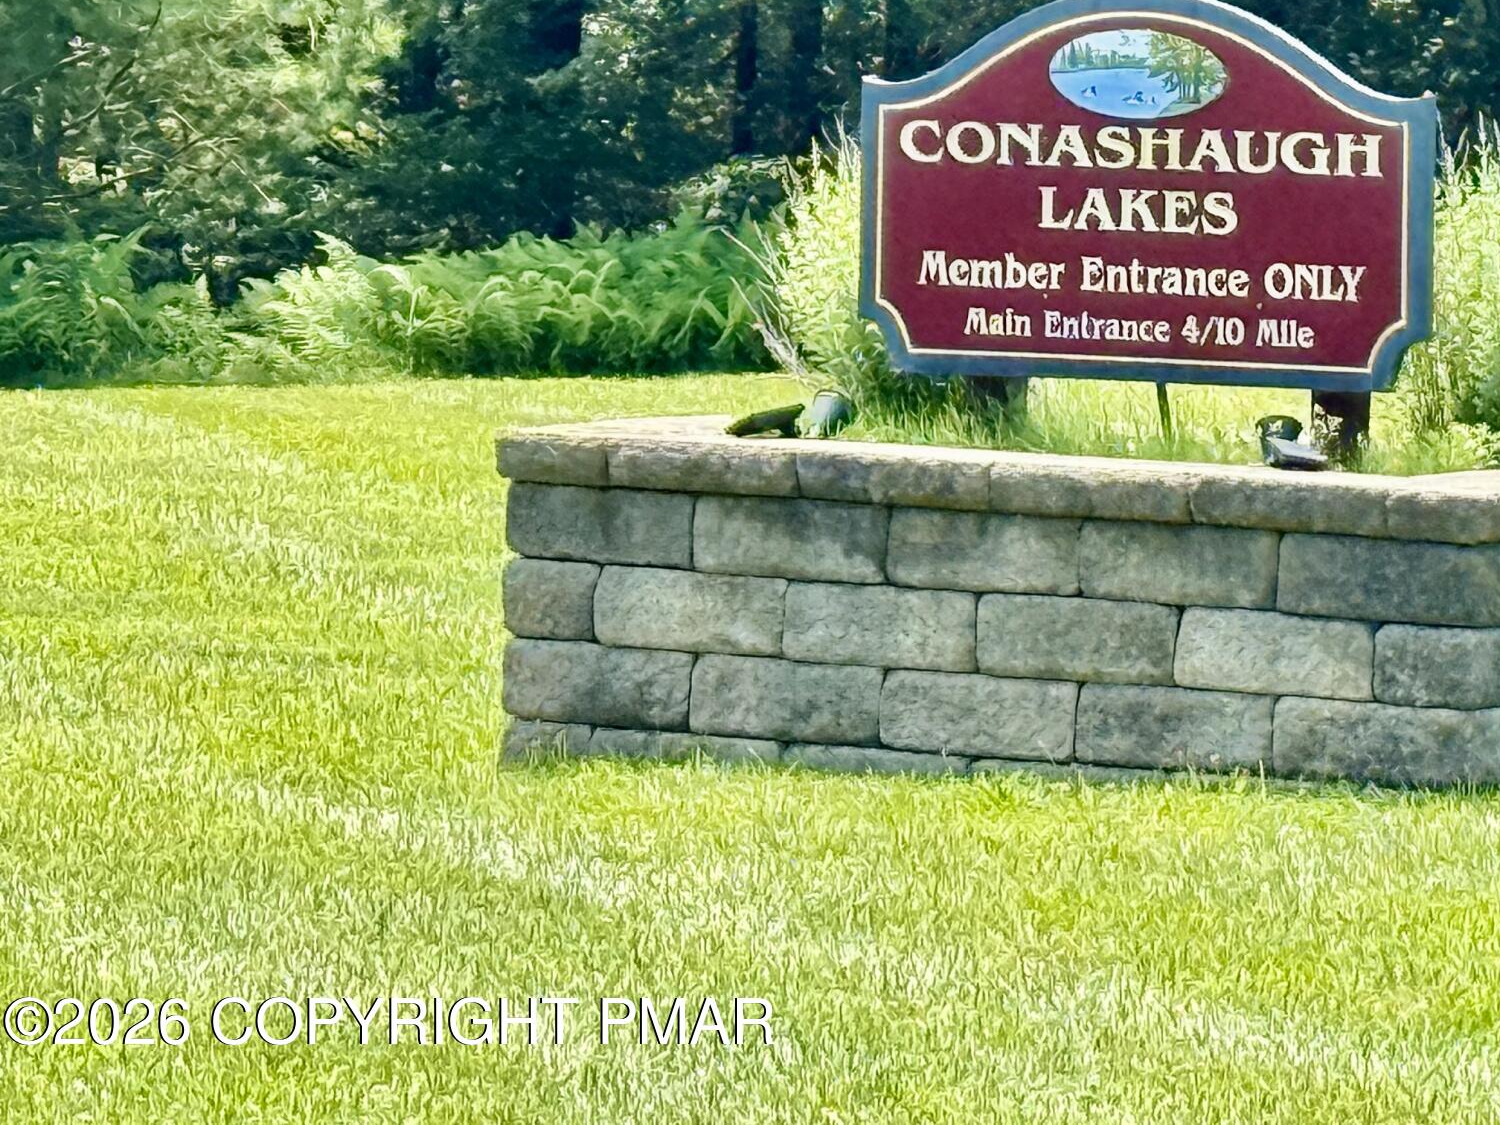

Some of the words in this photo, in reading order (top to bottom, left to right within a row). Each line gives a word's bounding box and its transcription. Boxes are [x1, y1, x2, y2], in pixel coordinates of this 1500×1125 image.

[899, 118, 1384, 178] CONASHAUGH
[1037, 186, 1239, 236] LAKES
[917, 250, 1067, 292] Member
[1080, 256, 1251, 298] Entrance
[1263, 262, 1367, 302] ONLY
[963, 307, 1032, 338] Main
[1043, 310, 1171, 343] Entrance
[1180, 313, 1246, 347] 4/10
[1256, 315, 1315, 349] Mile
